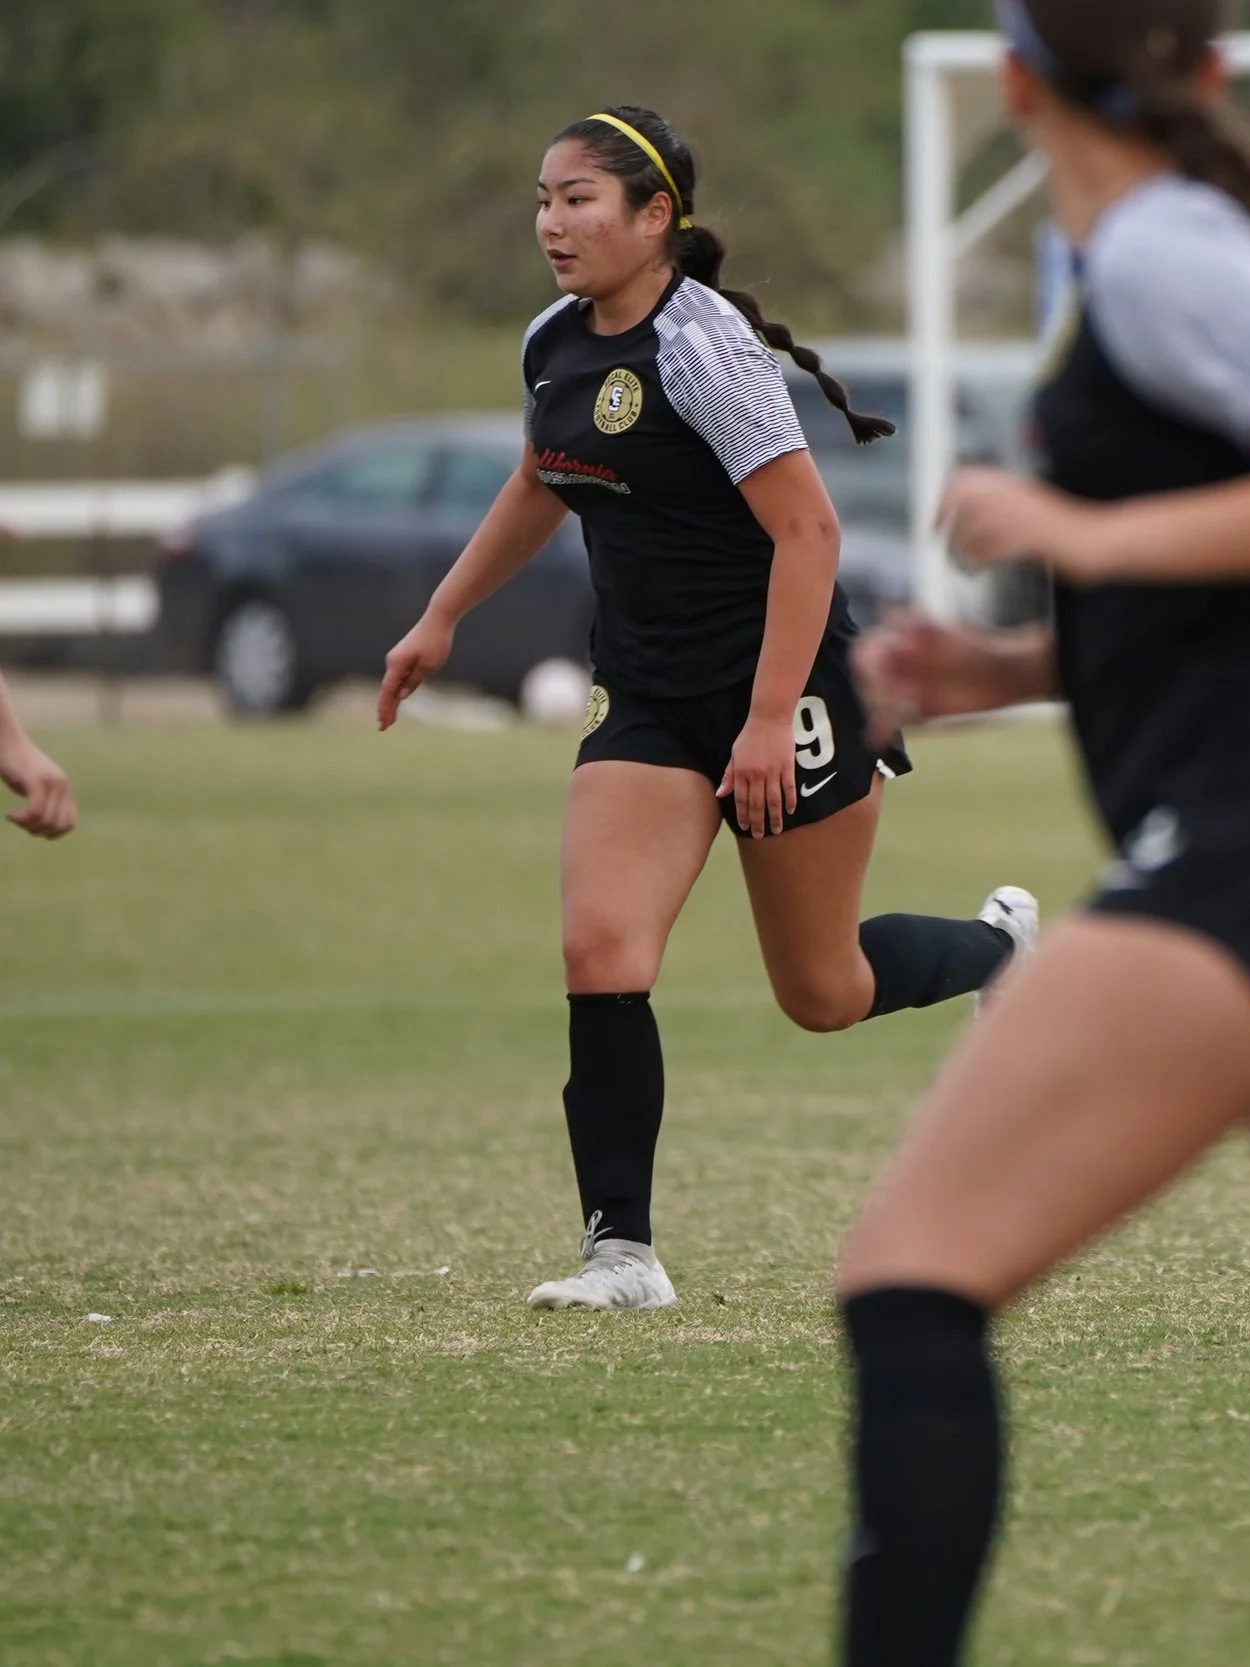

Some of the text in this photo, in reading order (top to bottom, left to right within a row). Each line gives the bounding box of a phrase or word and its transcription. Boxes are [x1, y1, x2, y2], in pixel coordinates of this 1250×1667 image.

[624, 373, 640, 392] ELITE
[618, 410, 637, 429] CLUB
[793, 695, 834, 770] 9
